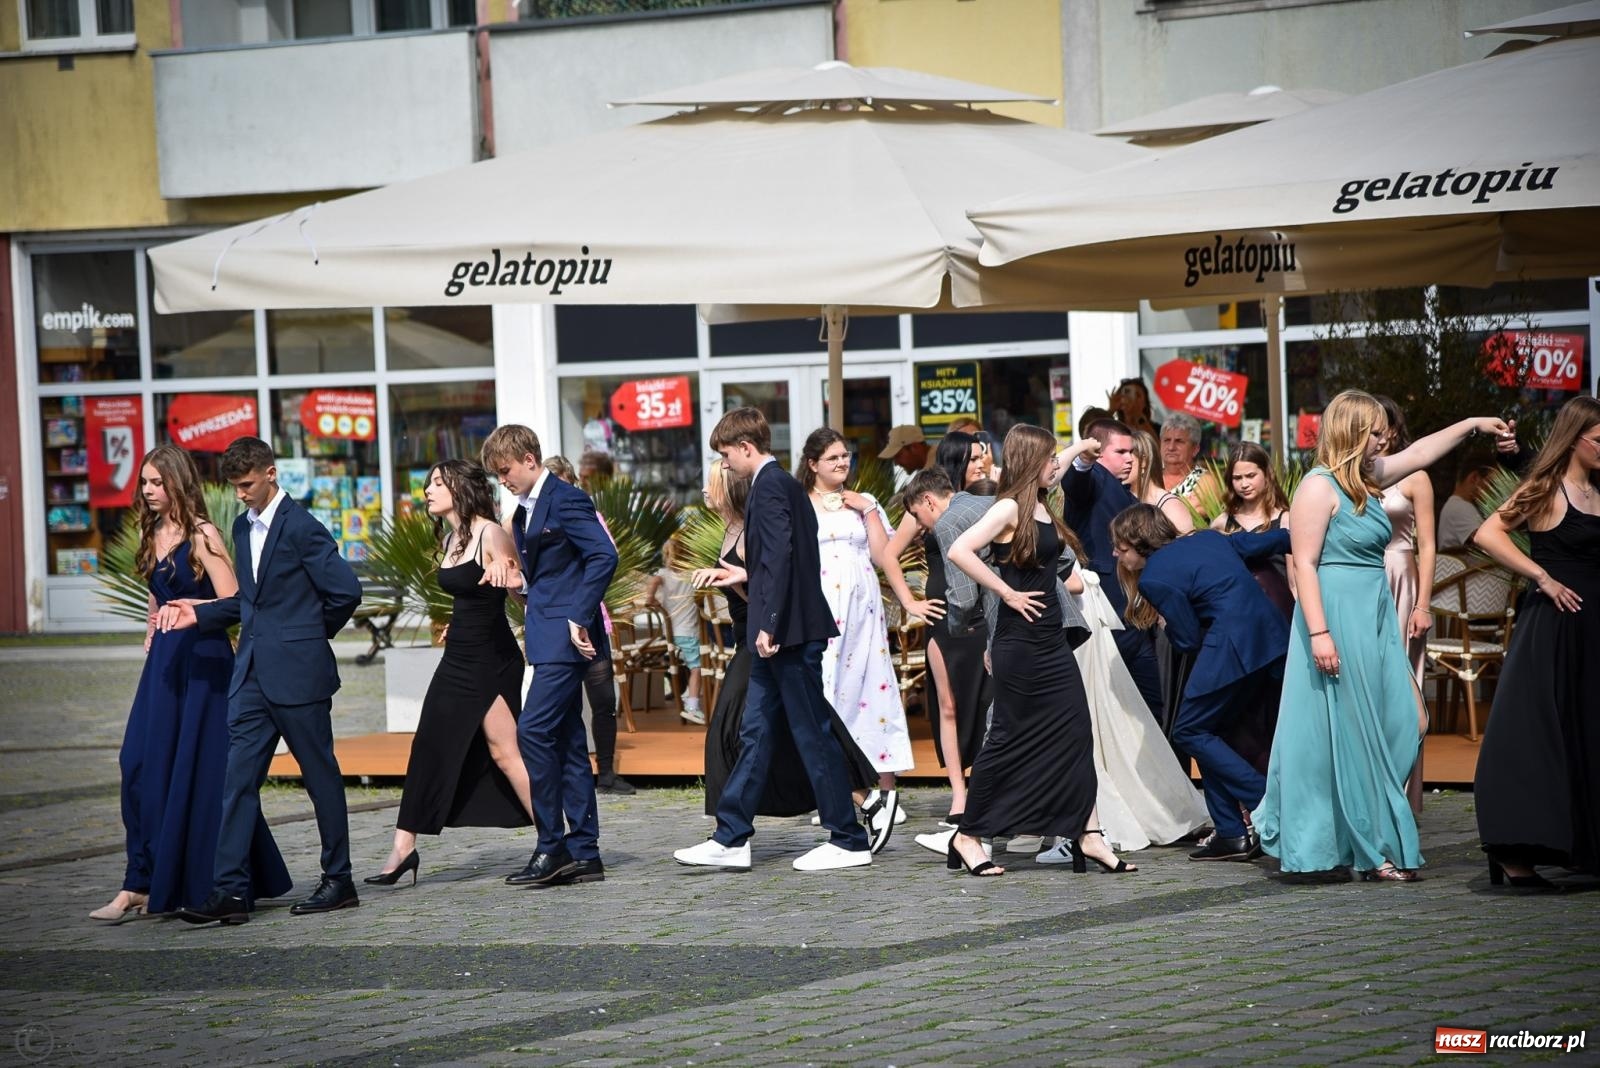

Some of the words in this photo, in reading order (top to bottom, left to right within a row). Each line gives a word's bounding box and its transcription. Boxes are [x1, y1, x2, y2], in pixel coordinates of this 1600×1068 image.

[1332, 162, 1560, 213] gelatopiu
[444, 246, 612, 297] gelatopiu
[1183, 232, 1296, 287] gelatopiu
[42, 302, 135, 333] empik.com
[936, 368, 957, 377] HITY
[636, 392, 666, 420] 35
[667, 396, 682, 417] zł
[921, 388, 976, 414] -35%
[1175, 376, 1239, 416] -70%
[178, 403, 254, 442] WYPRZEDAŻ
